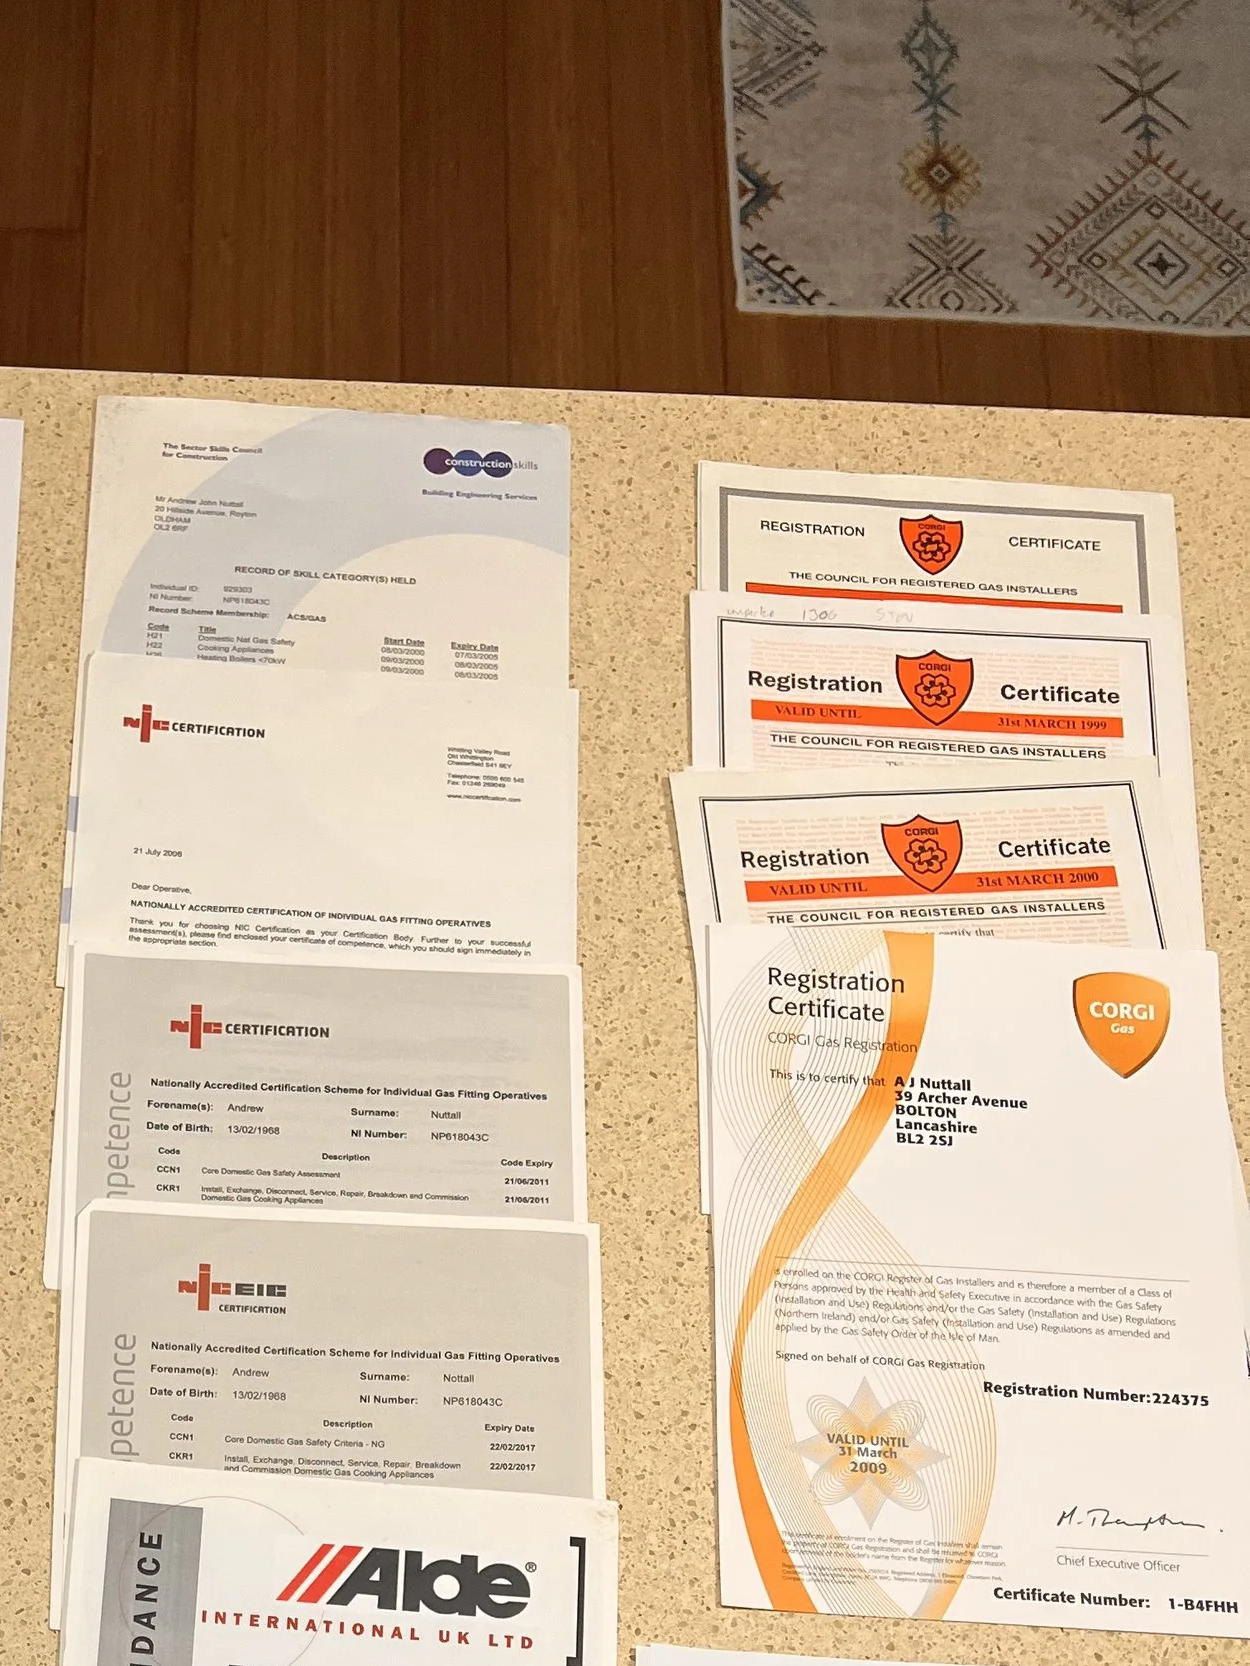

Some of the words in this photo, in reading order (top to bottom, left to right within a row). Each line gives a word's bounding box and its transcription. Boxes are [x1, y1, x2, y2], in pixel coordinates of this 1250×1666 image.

[759, 518, 865, 537] REGISTRATION
[916, 522, 946, 531] CORGI
[1007, 535, 1101, 552] CERTIFICATE
[233, 564, 276, 576] RECORD
[276, 567, 291, 577] OF
[291, 568, 321, 580] SKILL
[321, 570, 389, 584] CATEGORY(S)
[389, 575, 417, 585] HELD
[787, 570, 813, 581] THE
[814, 572, 870, 584] COUNCIL
[871, 575, 897, 586] FOR
[899, 577, 976, 590] REGISTERED
[977, 582, 1004, 593] GAS
[1005, 583, 1078, 596] INSTALLERS
[917, 661, 952, 672] CORGI
[747, 669, 883, 694] Registration
[999, 683, 1120, 704] Certificate
[170, 721, 266, 739] CERTIFICATION
[996, 716, 1021, 727] 31st
[1023, 717, 1076, 730] MARCH
[1080, 719, 1107, 730] 1999
[903, 826, 940, 837] CORGI
[997, 836, 1111, 859] Certificate
[739, 847, 870, 872] Registration
[130, 881, 151, 891] Dear
[975, 875, 1003, 888] 31st
[1005, 872, 1065, 886] MARCH
[1067, 870, 1099, 884] 2000
[767, 966, 905, 994] Registration
[767, 995, 885, 1023] Certificate
[1088, 1000, 1155, 1021] CORGI
[224, 1022, 330, 1039] CERTIFICATION
[1109, 1021, 1135, 1034] Gas
[892, 1074, 906, 1088] A
[908, 1076, 915, 1088] J
[919, 1076, 971, 1092] Nuttall
[893, 1088, 913, 1102] 39
[916, 1090, 968, 1106] Archer
[970, 1093, 1028, 1109] Avenue
[349, 1106, 399, 1118] Surname:
[429, 1109, 462, 1120] Nuttall
[893, 1102, 957, 1119] BOLTON
[894, 1117, 978, 1134] Lancashire
[895, 1131, 925, 1145] BL2
[927, 1133, 953, 1147] 2SJ
[217, 1302, 287, 1315] CERTIFICATION
[149, 1362, 218, 1377] Forename(s):
[230, 1366, 270, 1378] Andrew
[358, 1370, 410, 1382] Surname:
[982, 1379, 1079, 1399] Registration
[358, 1393, 371, 1404] NI
[372, 1393, 418, 1405] Number:
[442, 1395, 503, 1407] NP618043C
[168, 1431, 194, 1442] CCN1
[488, 1441, 536, 1452] 22/02/2017
[167, 1450, 193, 1461] CKR1
[992, 1585, 1076, 1604] Certificate
[1079, 1591, 1151, 1609] Number:
[1167, 1597, 1239, 1614] 1-B4FHH
[201, 1610, 419, 1640] INTERNATIONAL
[437, 1628, 470, 1645] UK
[487, 1632, 533, 1650] LTD
